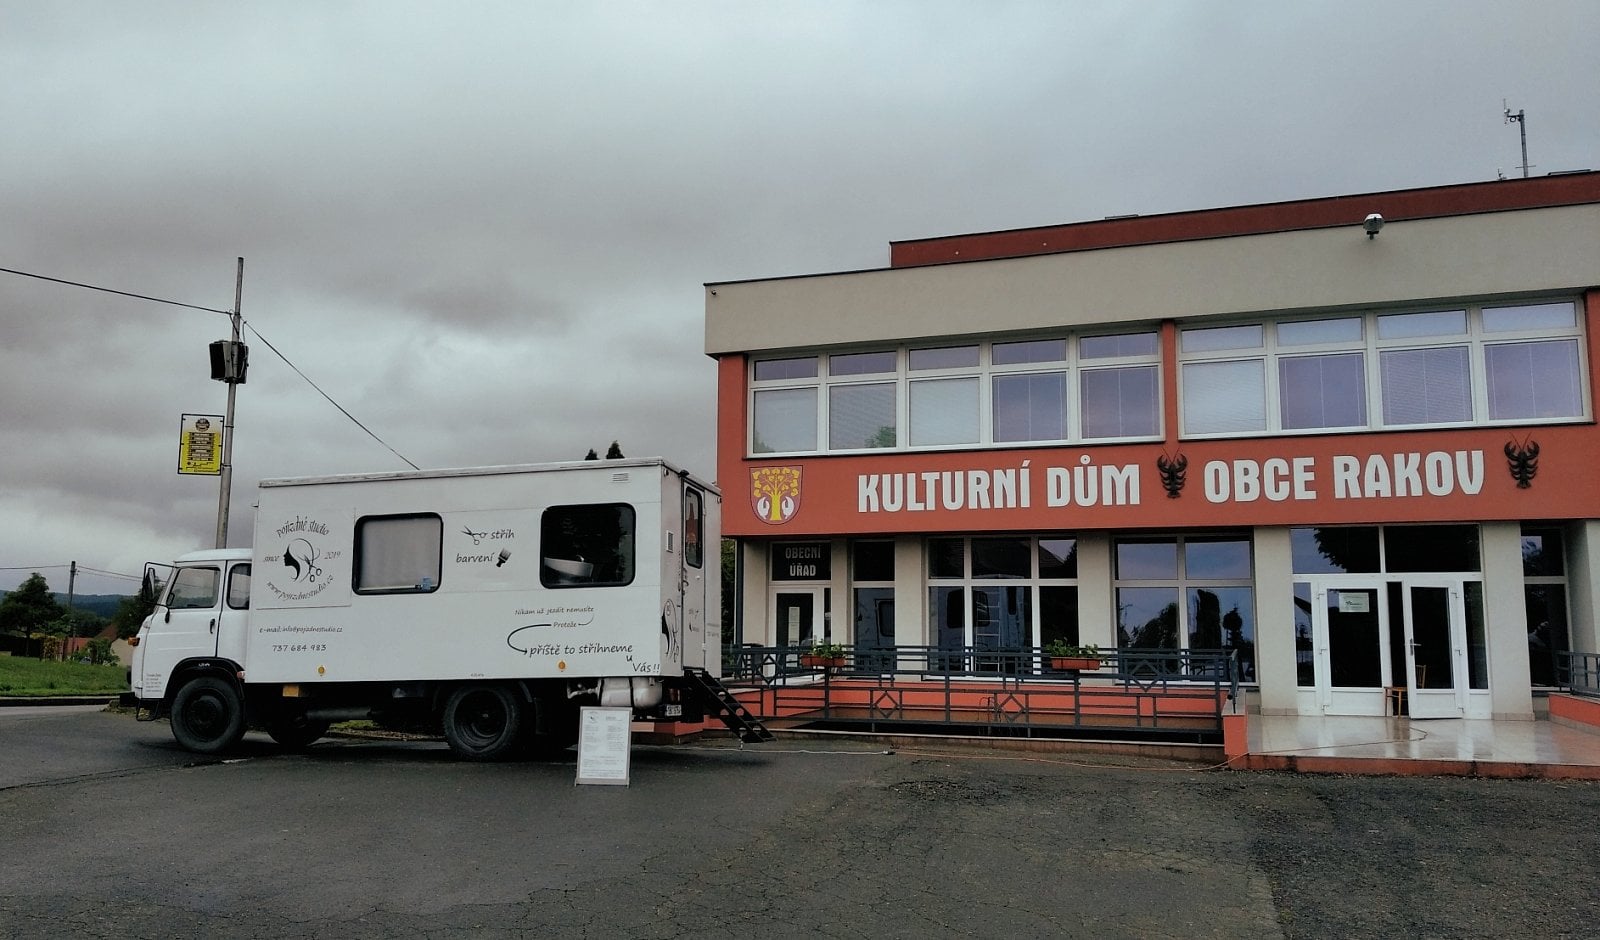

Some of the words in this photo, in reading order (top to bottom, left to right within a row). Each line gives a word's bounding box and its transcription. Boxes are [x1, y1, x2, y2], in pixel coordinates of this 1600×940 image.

[858, 459, 1031, 513] KULTURNÍ
[1046, 454, 1141, 508] DŮM
[1204, 457, 1317, 503] OBCE
[1333, 450, 1485, 499] RAKOV
[308, 520, 330, 536] studio
[490, 529, 515, 540] střih
[456, 552, 495, 563] barvení
[785, 545, 821, 559] OBECNÍ
[789, 562, 817, 577] ÚŘAD
[546, 607, 564, 616] jezdit
[272, 644, 288, 652] 737
[290, 644, 307, 652] 684
[310, 644, 327, 652] 983
[529, 643, 560, 659] příště
[564, 645, 575, 655] to
[578, 642, 633, 654] střihneme
